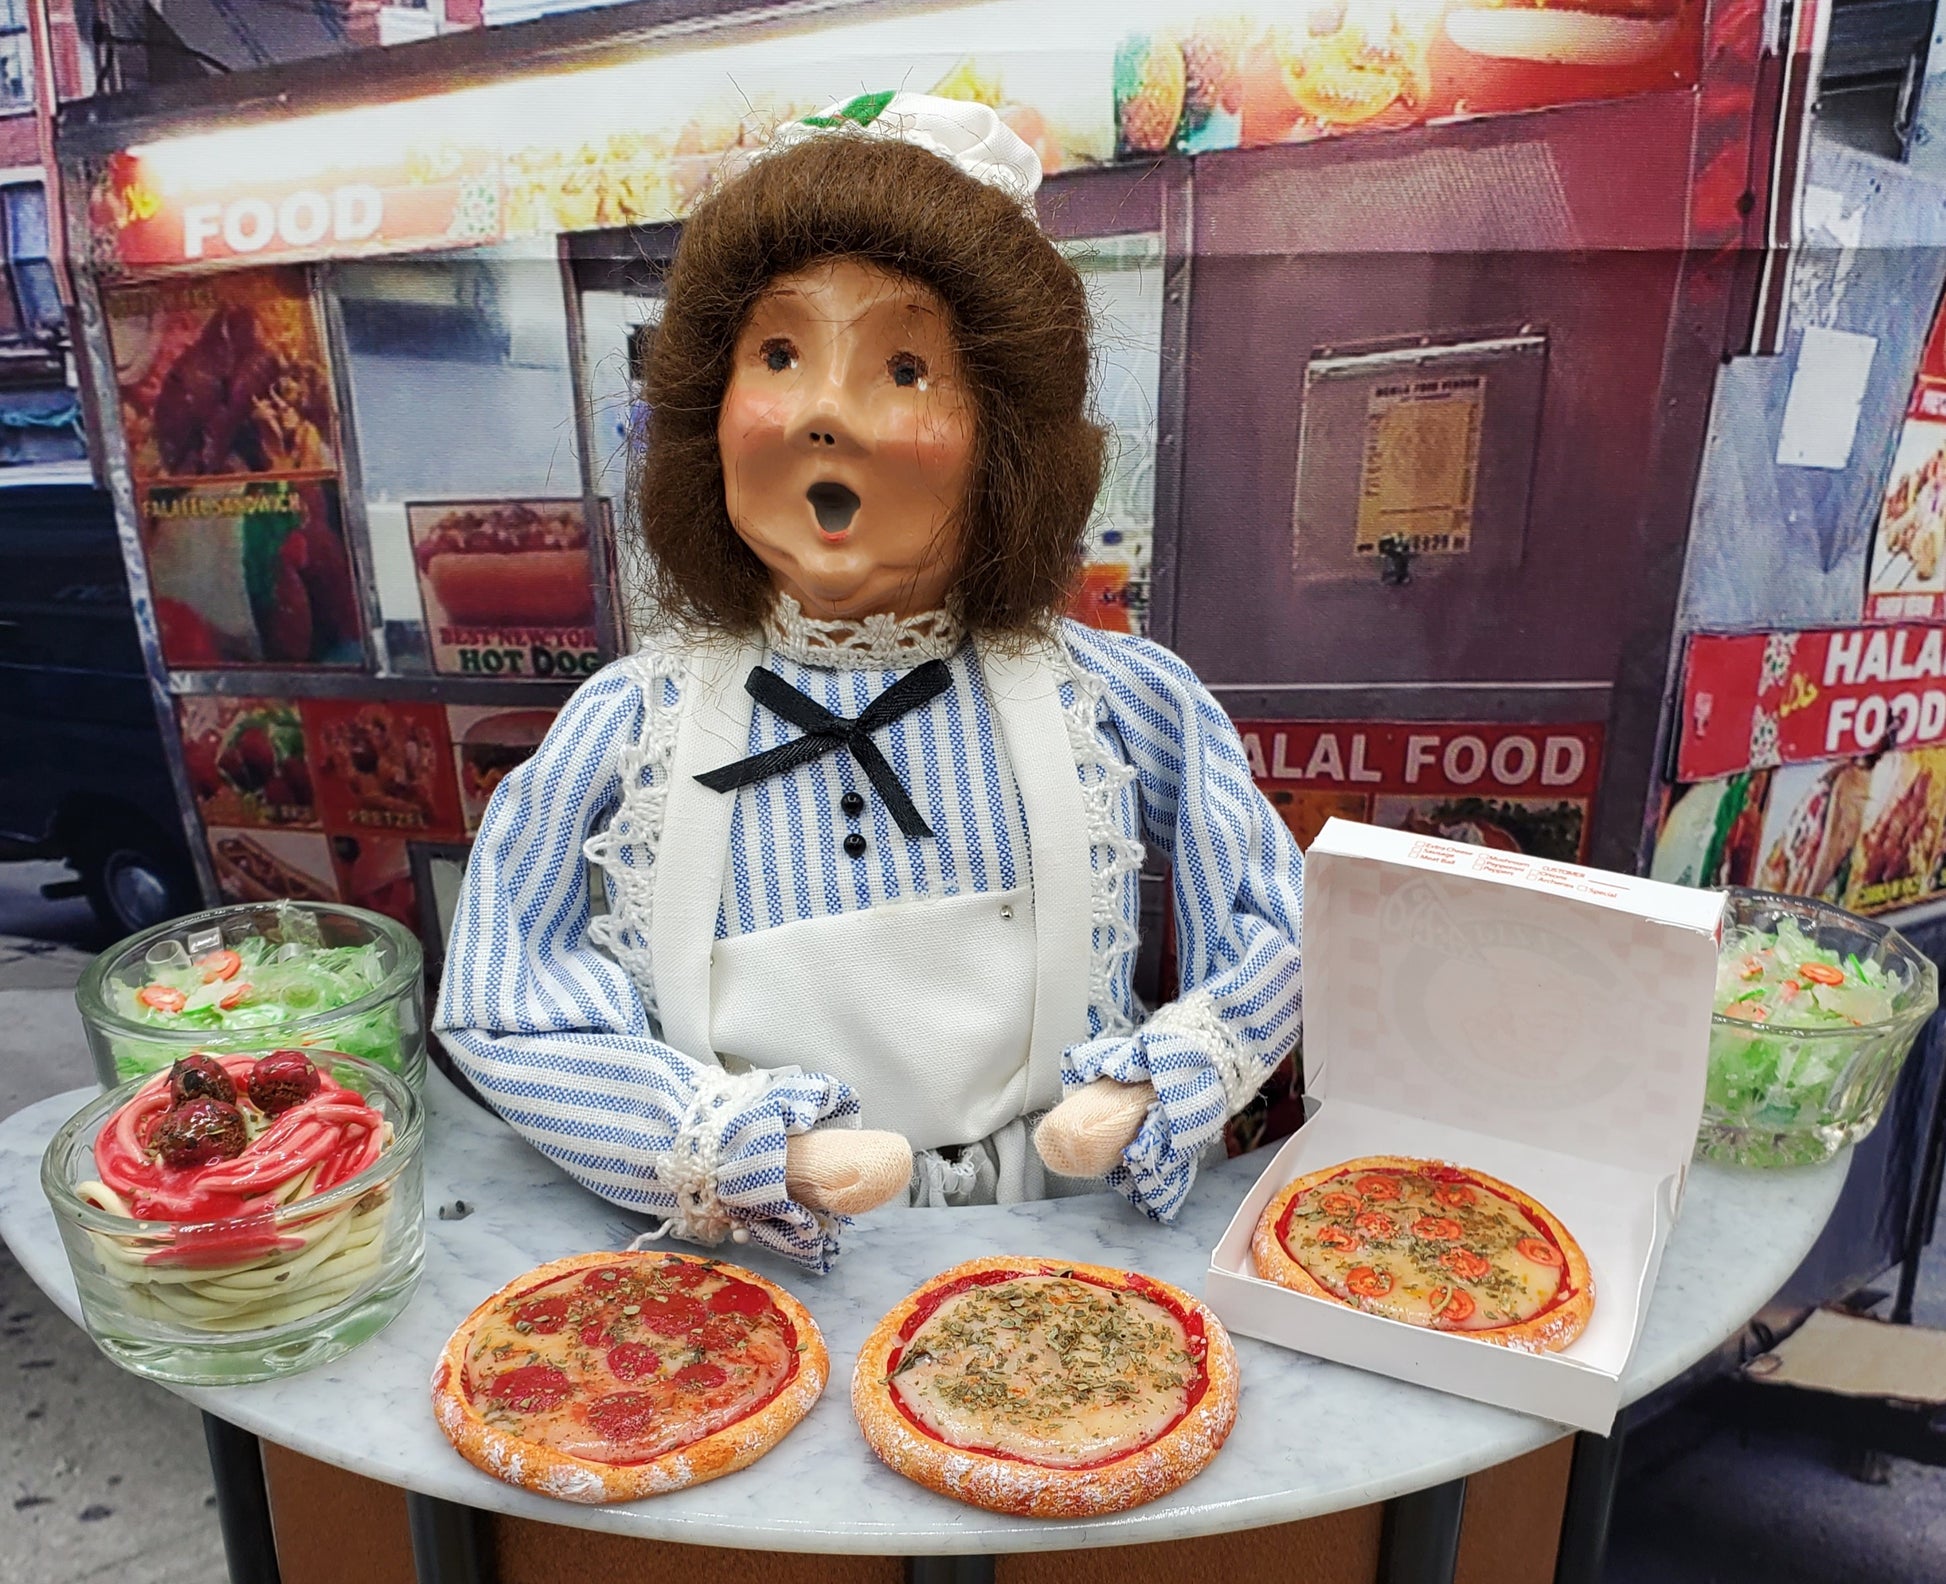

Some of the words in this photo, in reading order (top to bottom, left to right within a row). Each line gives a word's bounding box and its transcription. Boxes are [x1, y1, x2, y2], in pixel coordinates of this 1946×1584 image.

[184, 183, 384, 259] FOOD
[548, 627, 598, 649] YOR
[1823, 628, 1946, 687] HALA
[459, 647, 524, 673] HOT
[1825, 690, 1946, 752] FOOD
[1242, 732, 1383, 783] ALAL
[1405, 735, 1587, 786] FOOD
[1542, 865, 1586, 878] CUSTOMER
[1587, 886, 1618, 899] Special
